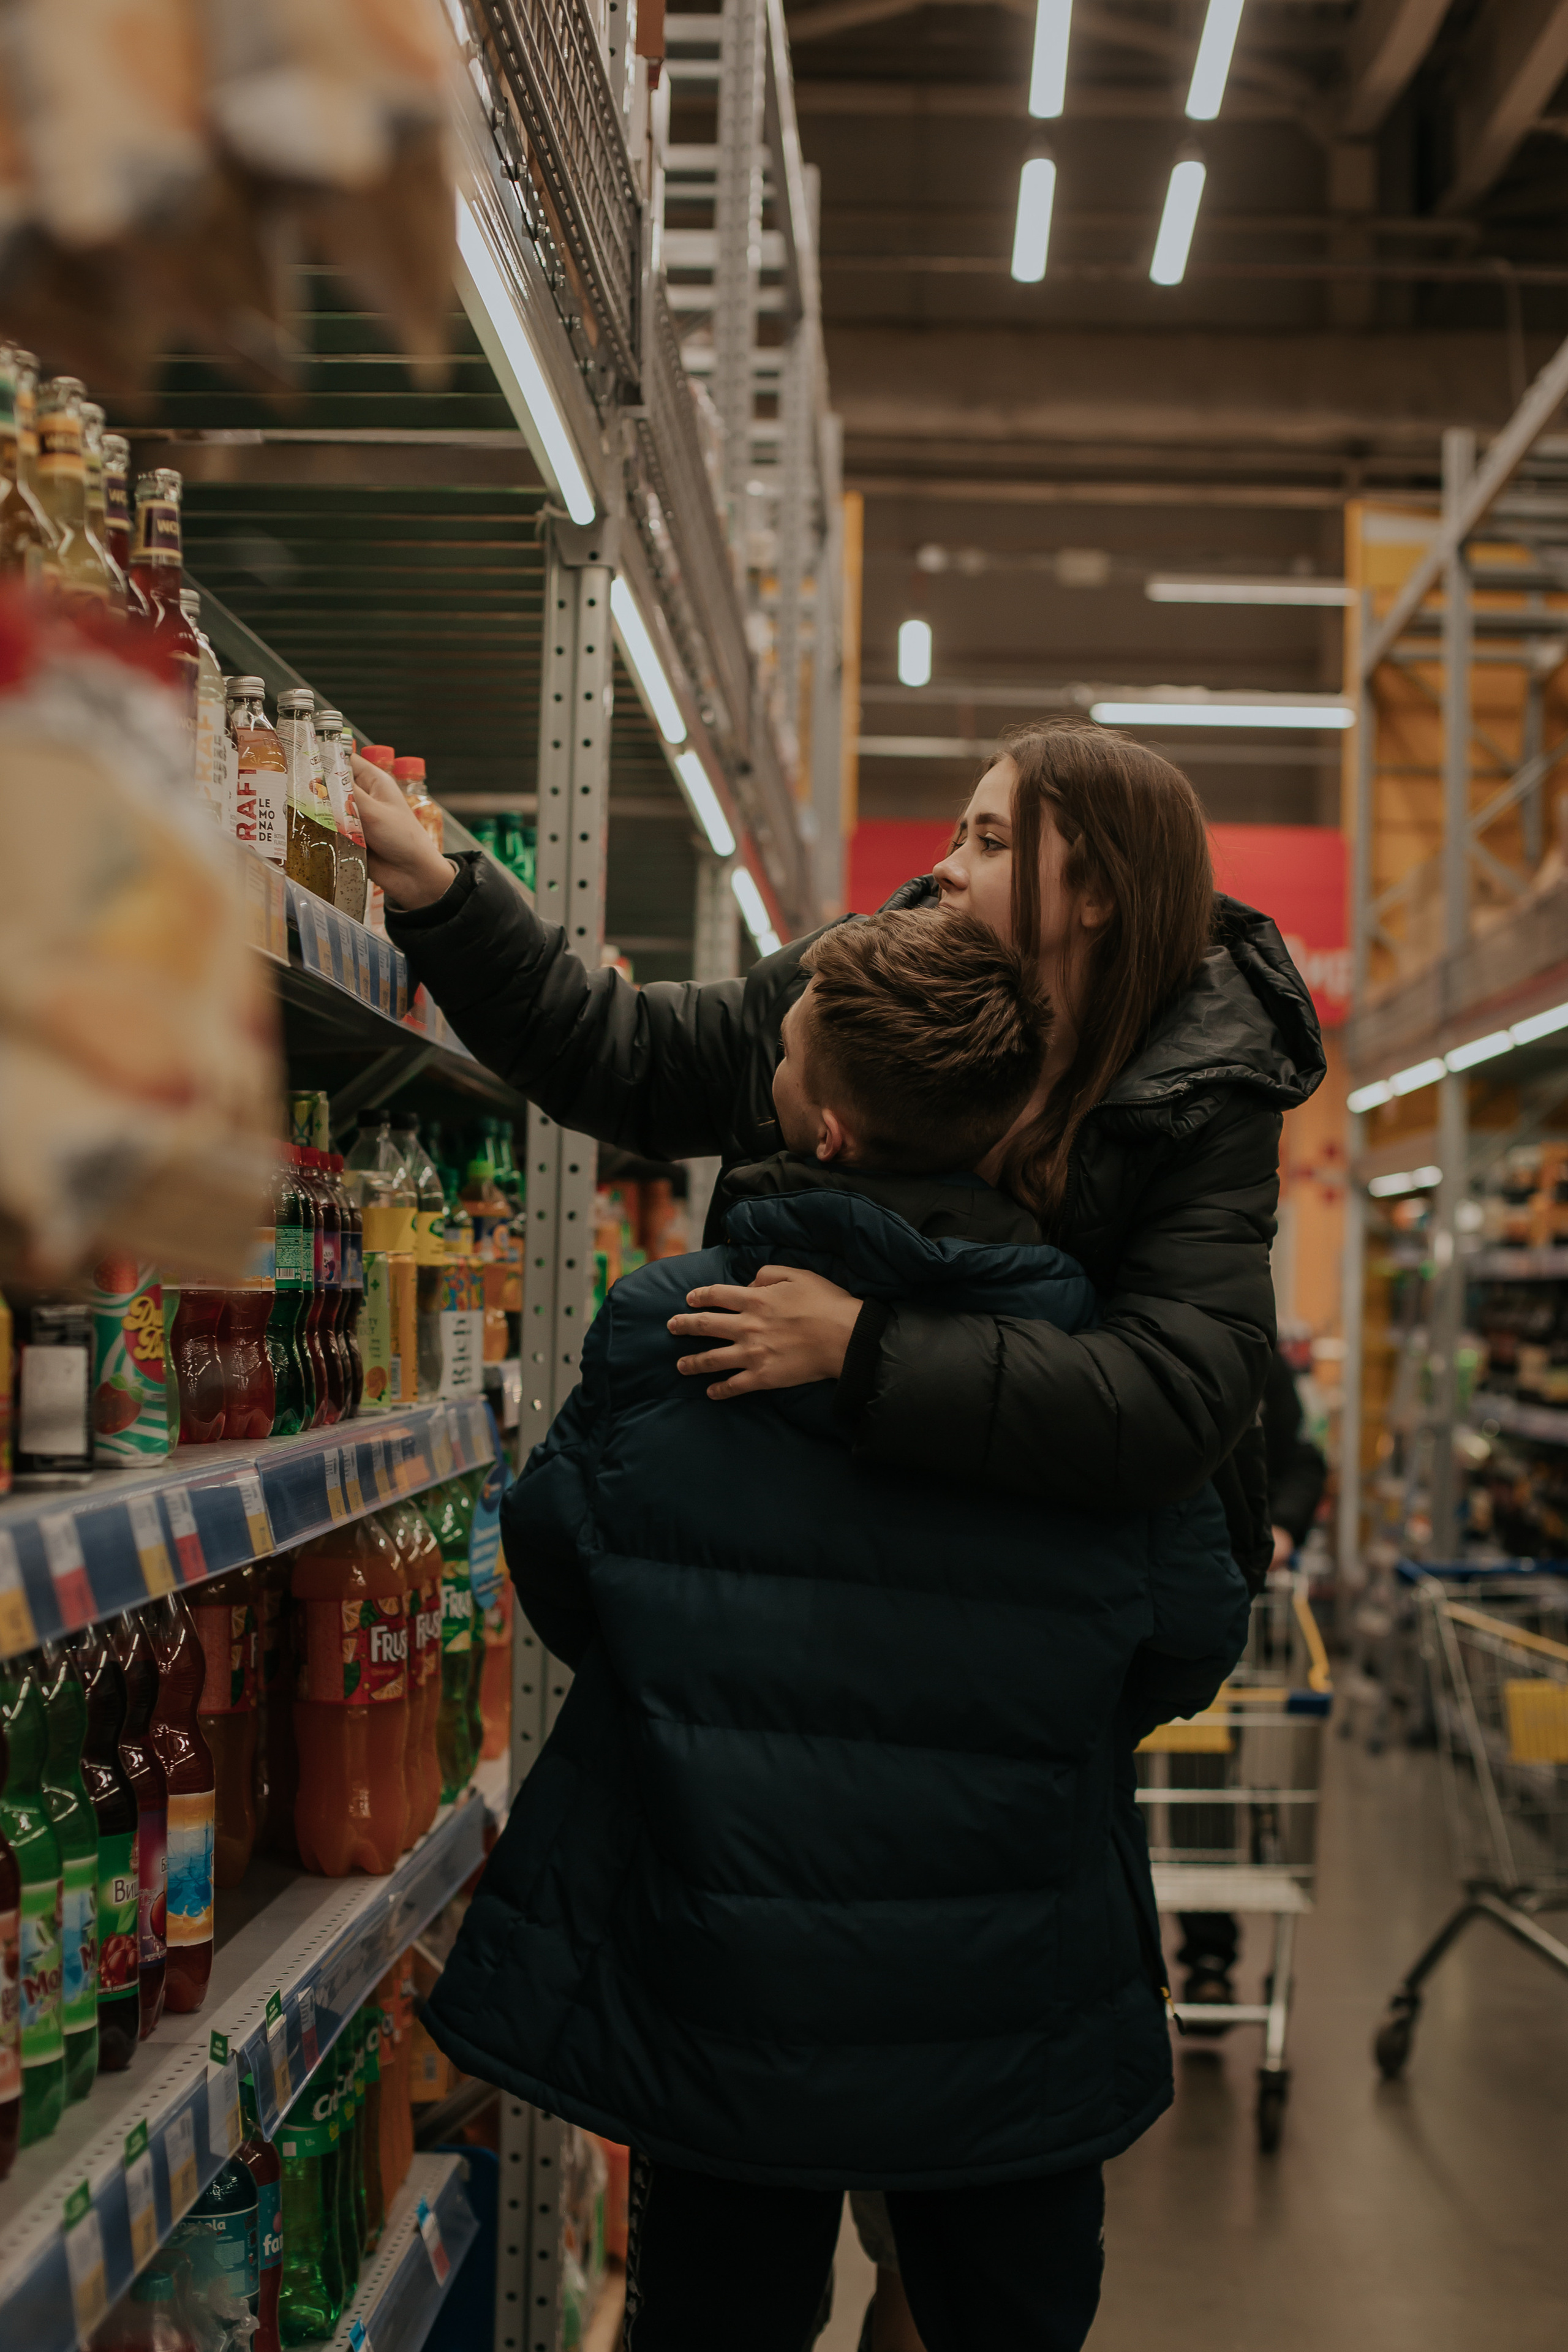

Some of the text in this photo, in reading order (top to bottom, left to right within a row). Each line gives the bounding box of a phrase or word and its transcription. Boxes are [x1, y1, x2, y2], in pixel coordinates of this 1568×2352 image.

[258, 798, 270, 808] LE
[236, 769, 257, 853] RAFT
[258, 809, 274, 820] MO
[258, 821, 274, 831] NA
[258, 832, 272, 842] DE
